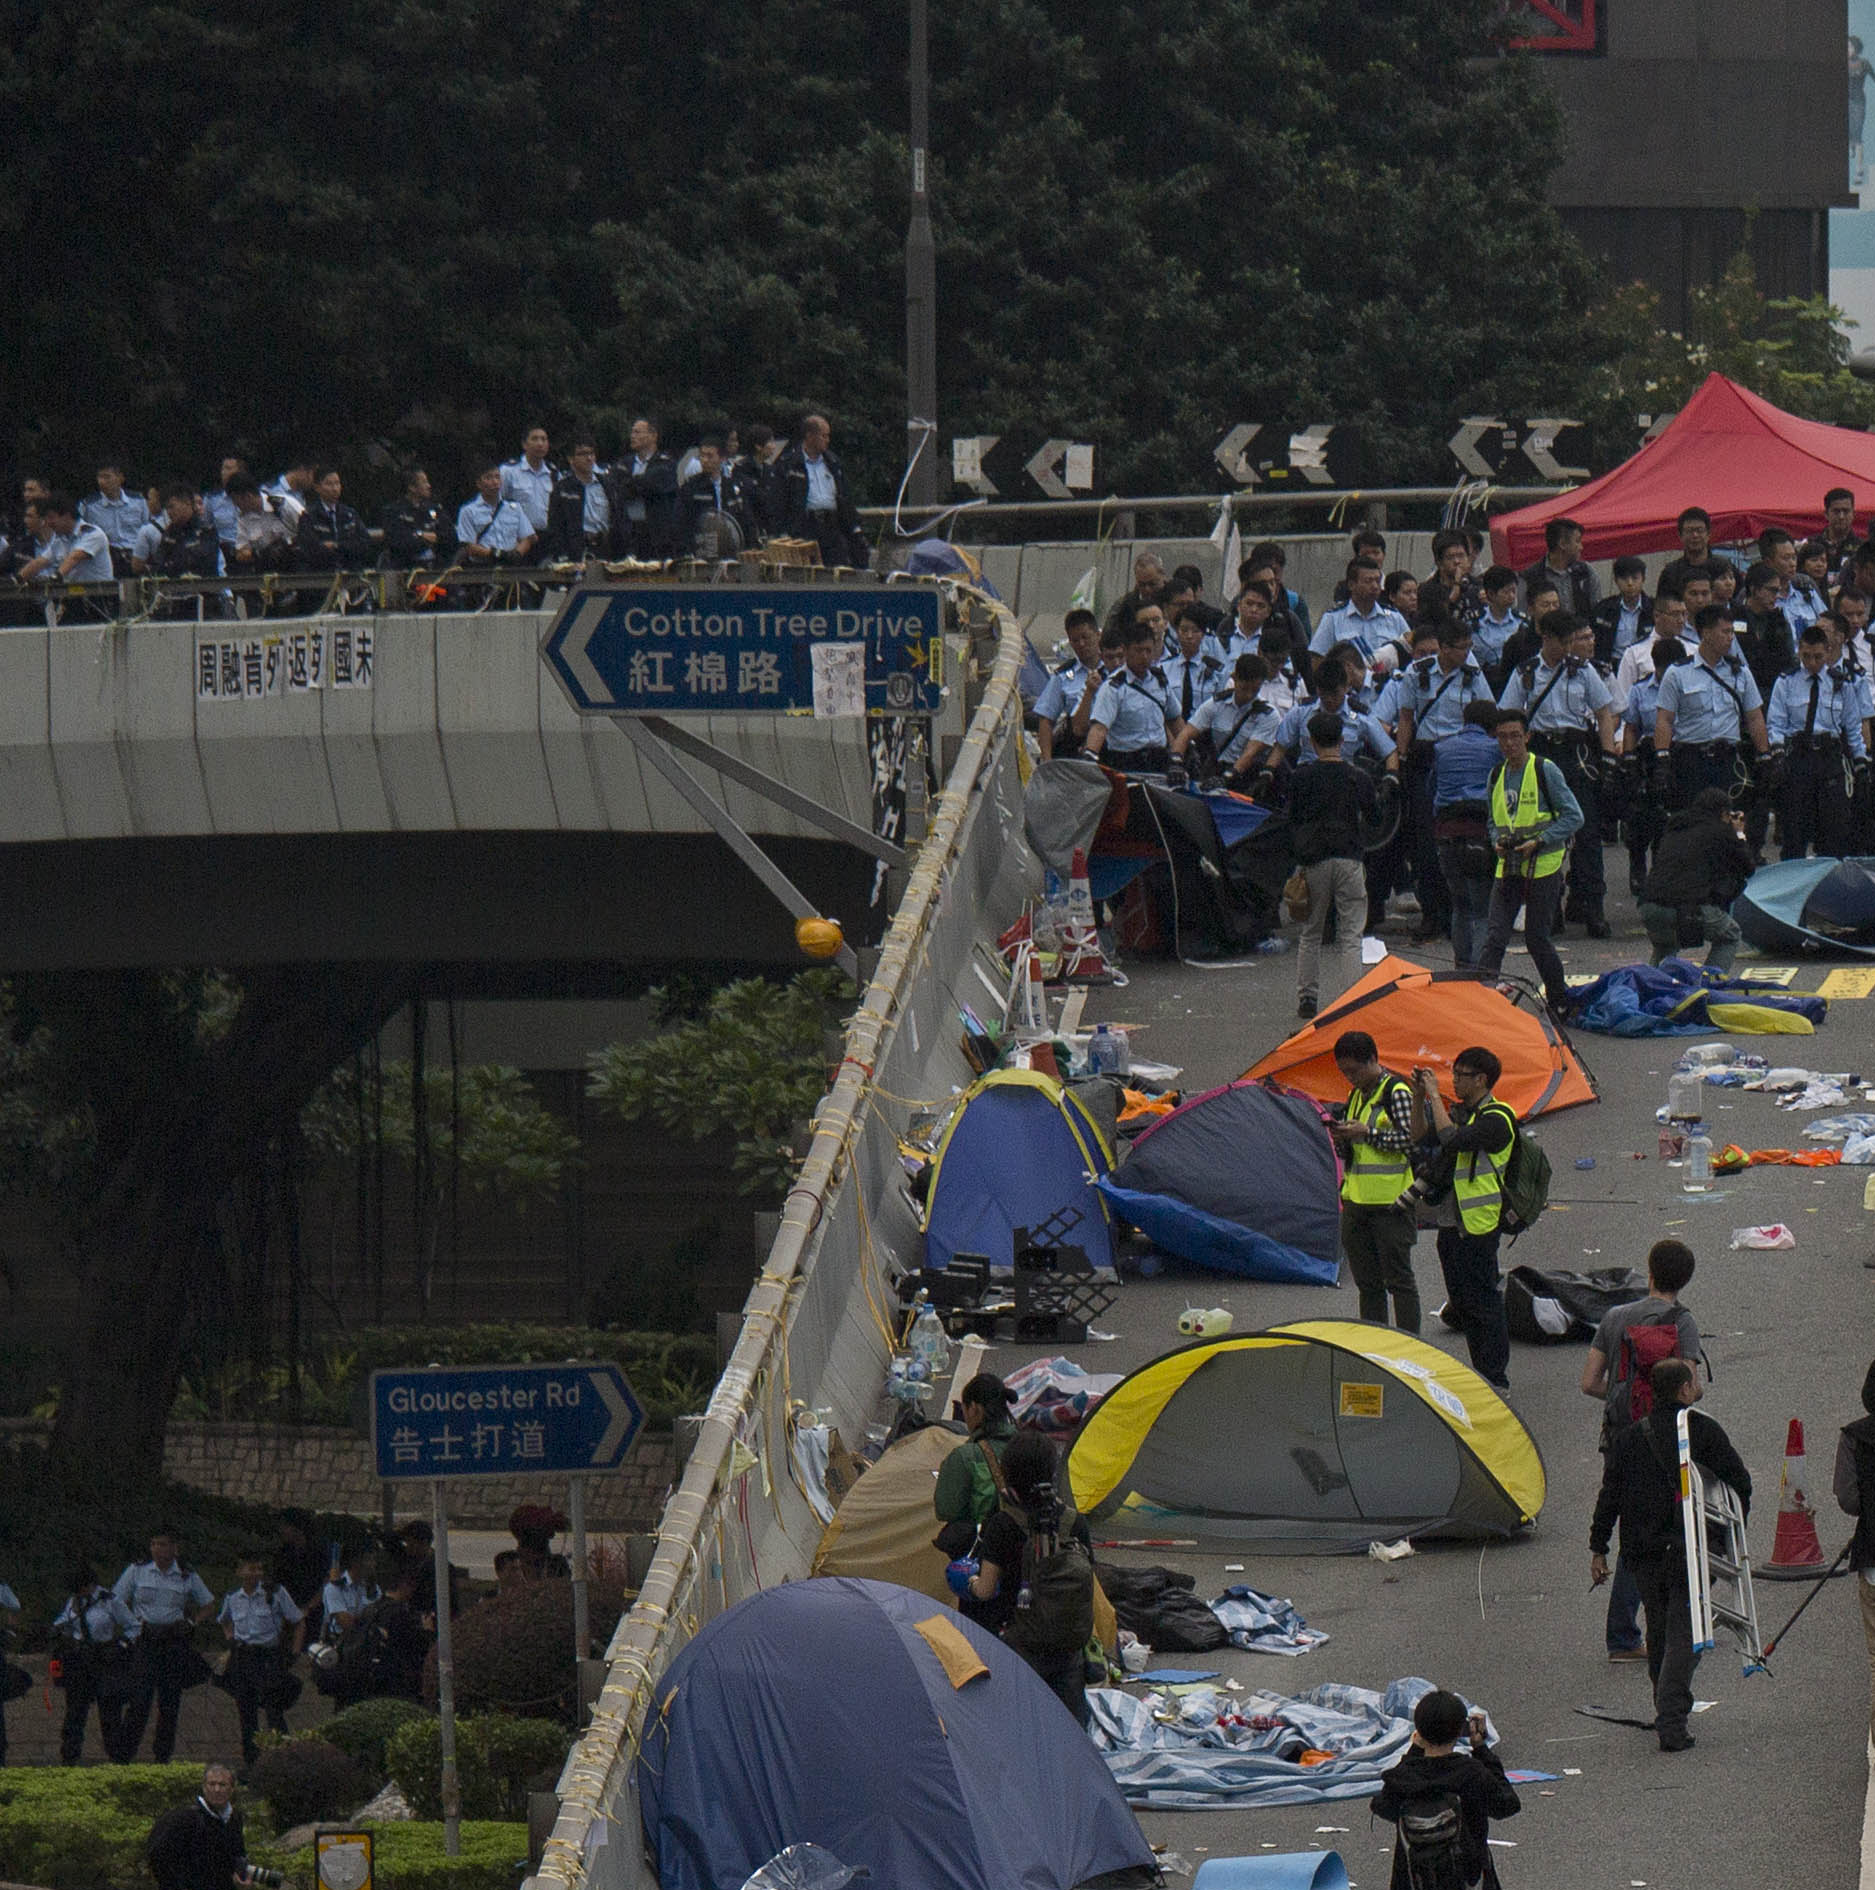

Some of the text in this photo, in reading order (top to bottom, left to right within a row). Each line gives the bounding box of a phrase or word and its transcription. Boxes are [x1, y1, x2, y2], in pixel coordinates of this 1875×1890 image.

[624, 607, 924, 638] Cotton Tree Drive
[628, 650, 783, 695] 紅棉路
[387, 1382, 580, 1414] Gloucester Rd
[389, 1420, 546, 1463] 告士打道
